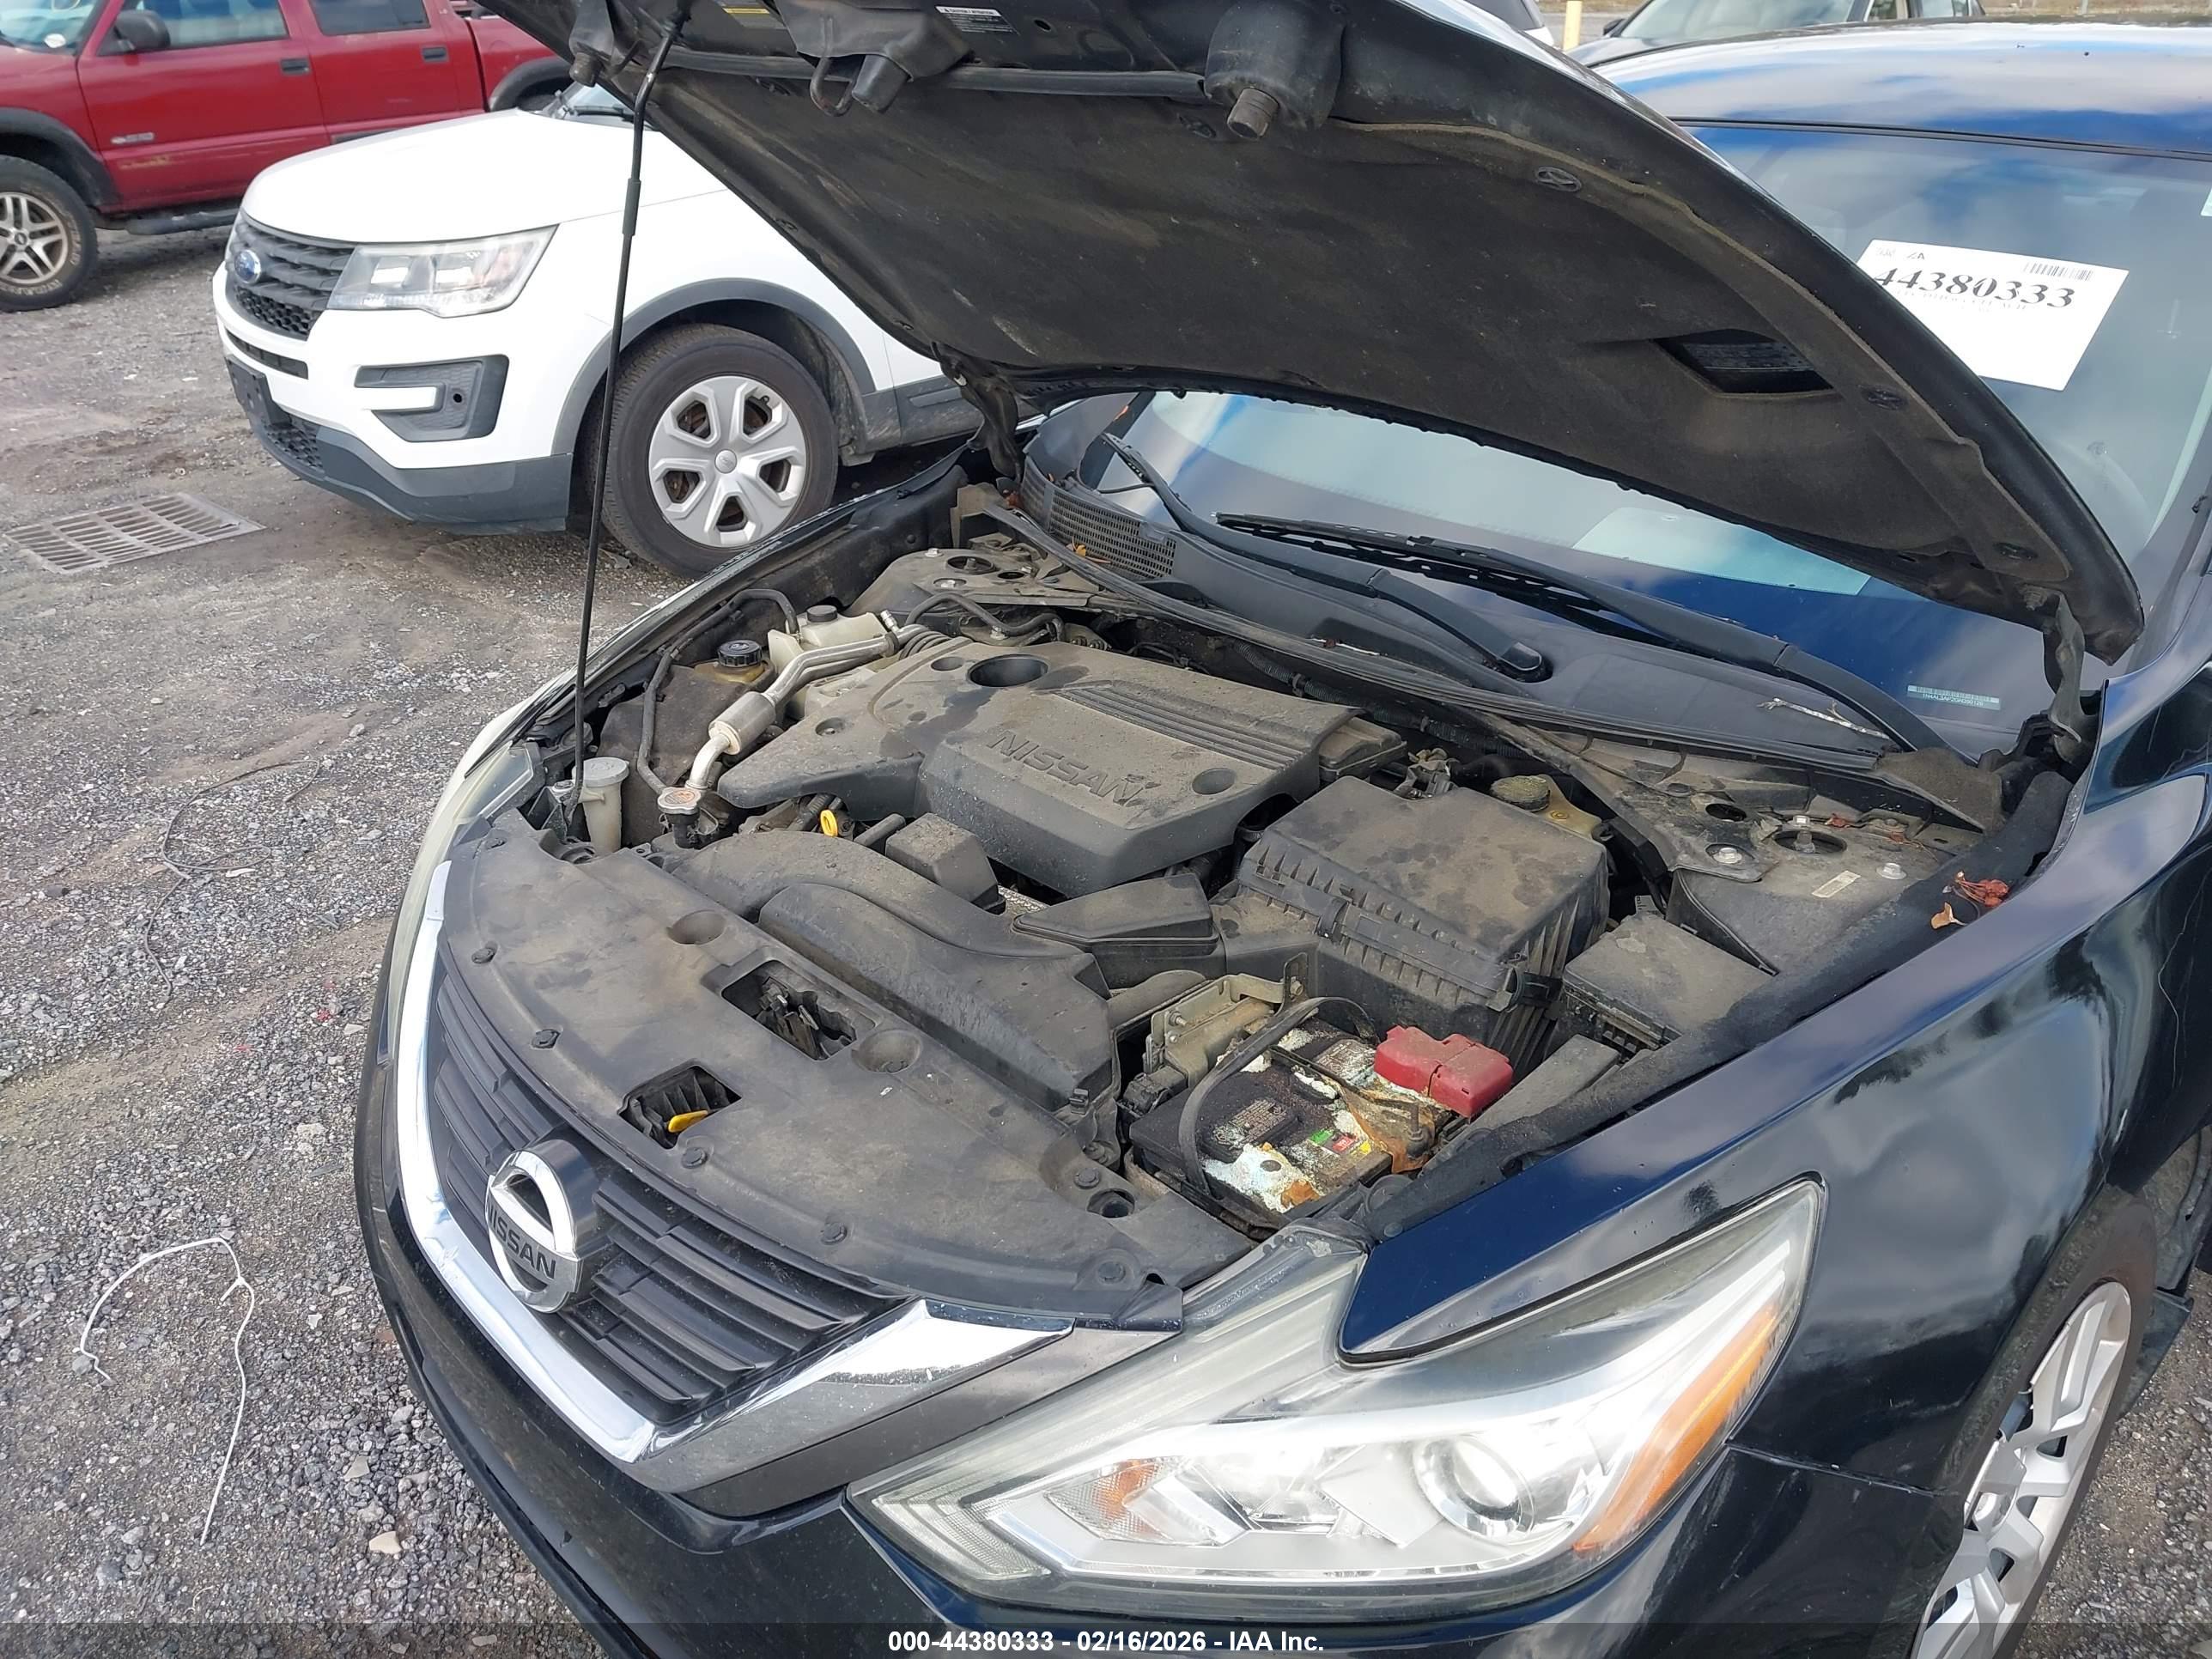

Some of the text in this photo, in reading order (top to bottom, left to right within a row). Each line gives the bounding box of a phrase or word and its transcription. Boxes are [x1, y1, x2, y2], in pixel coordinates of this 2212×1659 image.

[1873, 267, 2075, 307] 44380333
[987, 730, 1146, 806] NISSAN
[487, 1200, 556, 1279] NISSAN
